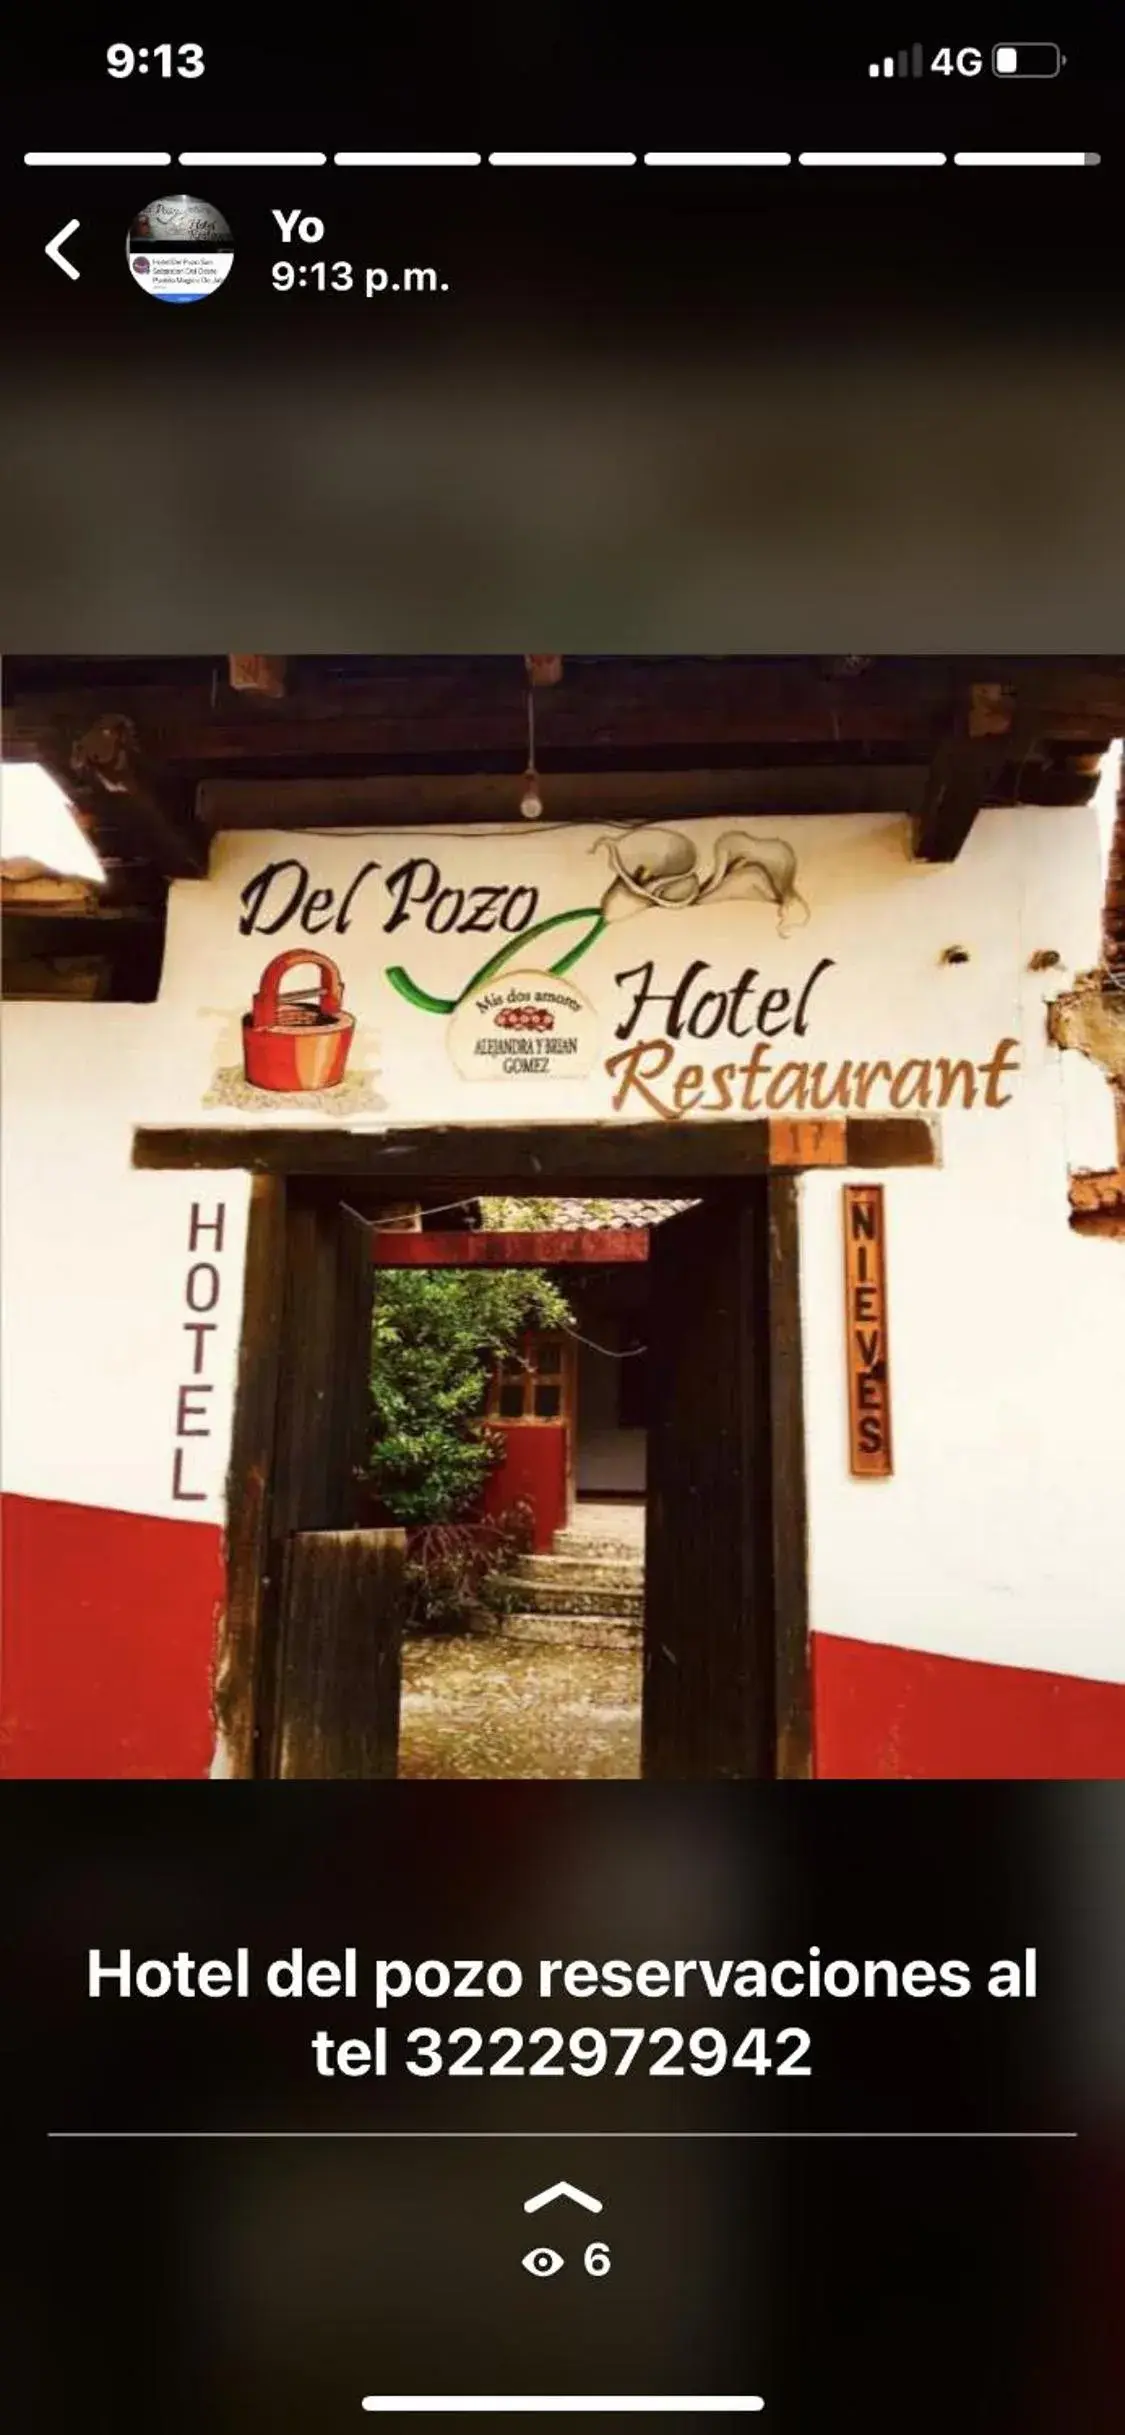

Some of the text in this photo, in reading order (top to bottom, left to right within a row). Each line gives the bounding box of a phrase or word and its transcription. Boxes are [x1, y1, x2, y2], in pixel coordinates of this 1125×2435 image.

[239, 857, 539, 935] Del Pozo
[476, 986, 583, 1014] Mis dos amores
[614, 957, 836, 1040] Hotel
[474, 1036, 578, 1058] ALEJANDRA Y BRIAN
[502, 1056, 551, 1075] GOMEZ
[603, 1037, 1021, 1120] Restaurant
[172, 1202, 226, 1502] HOTEL
[851, 1201, 883, 1454] NIEVES
